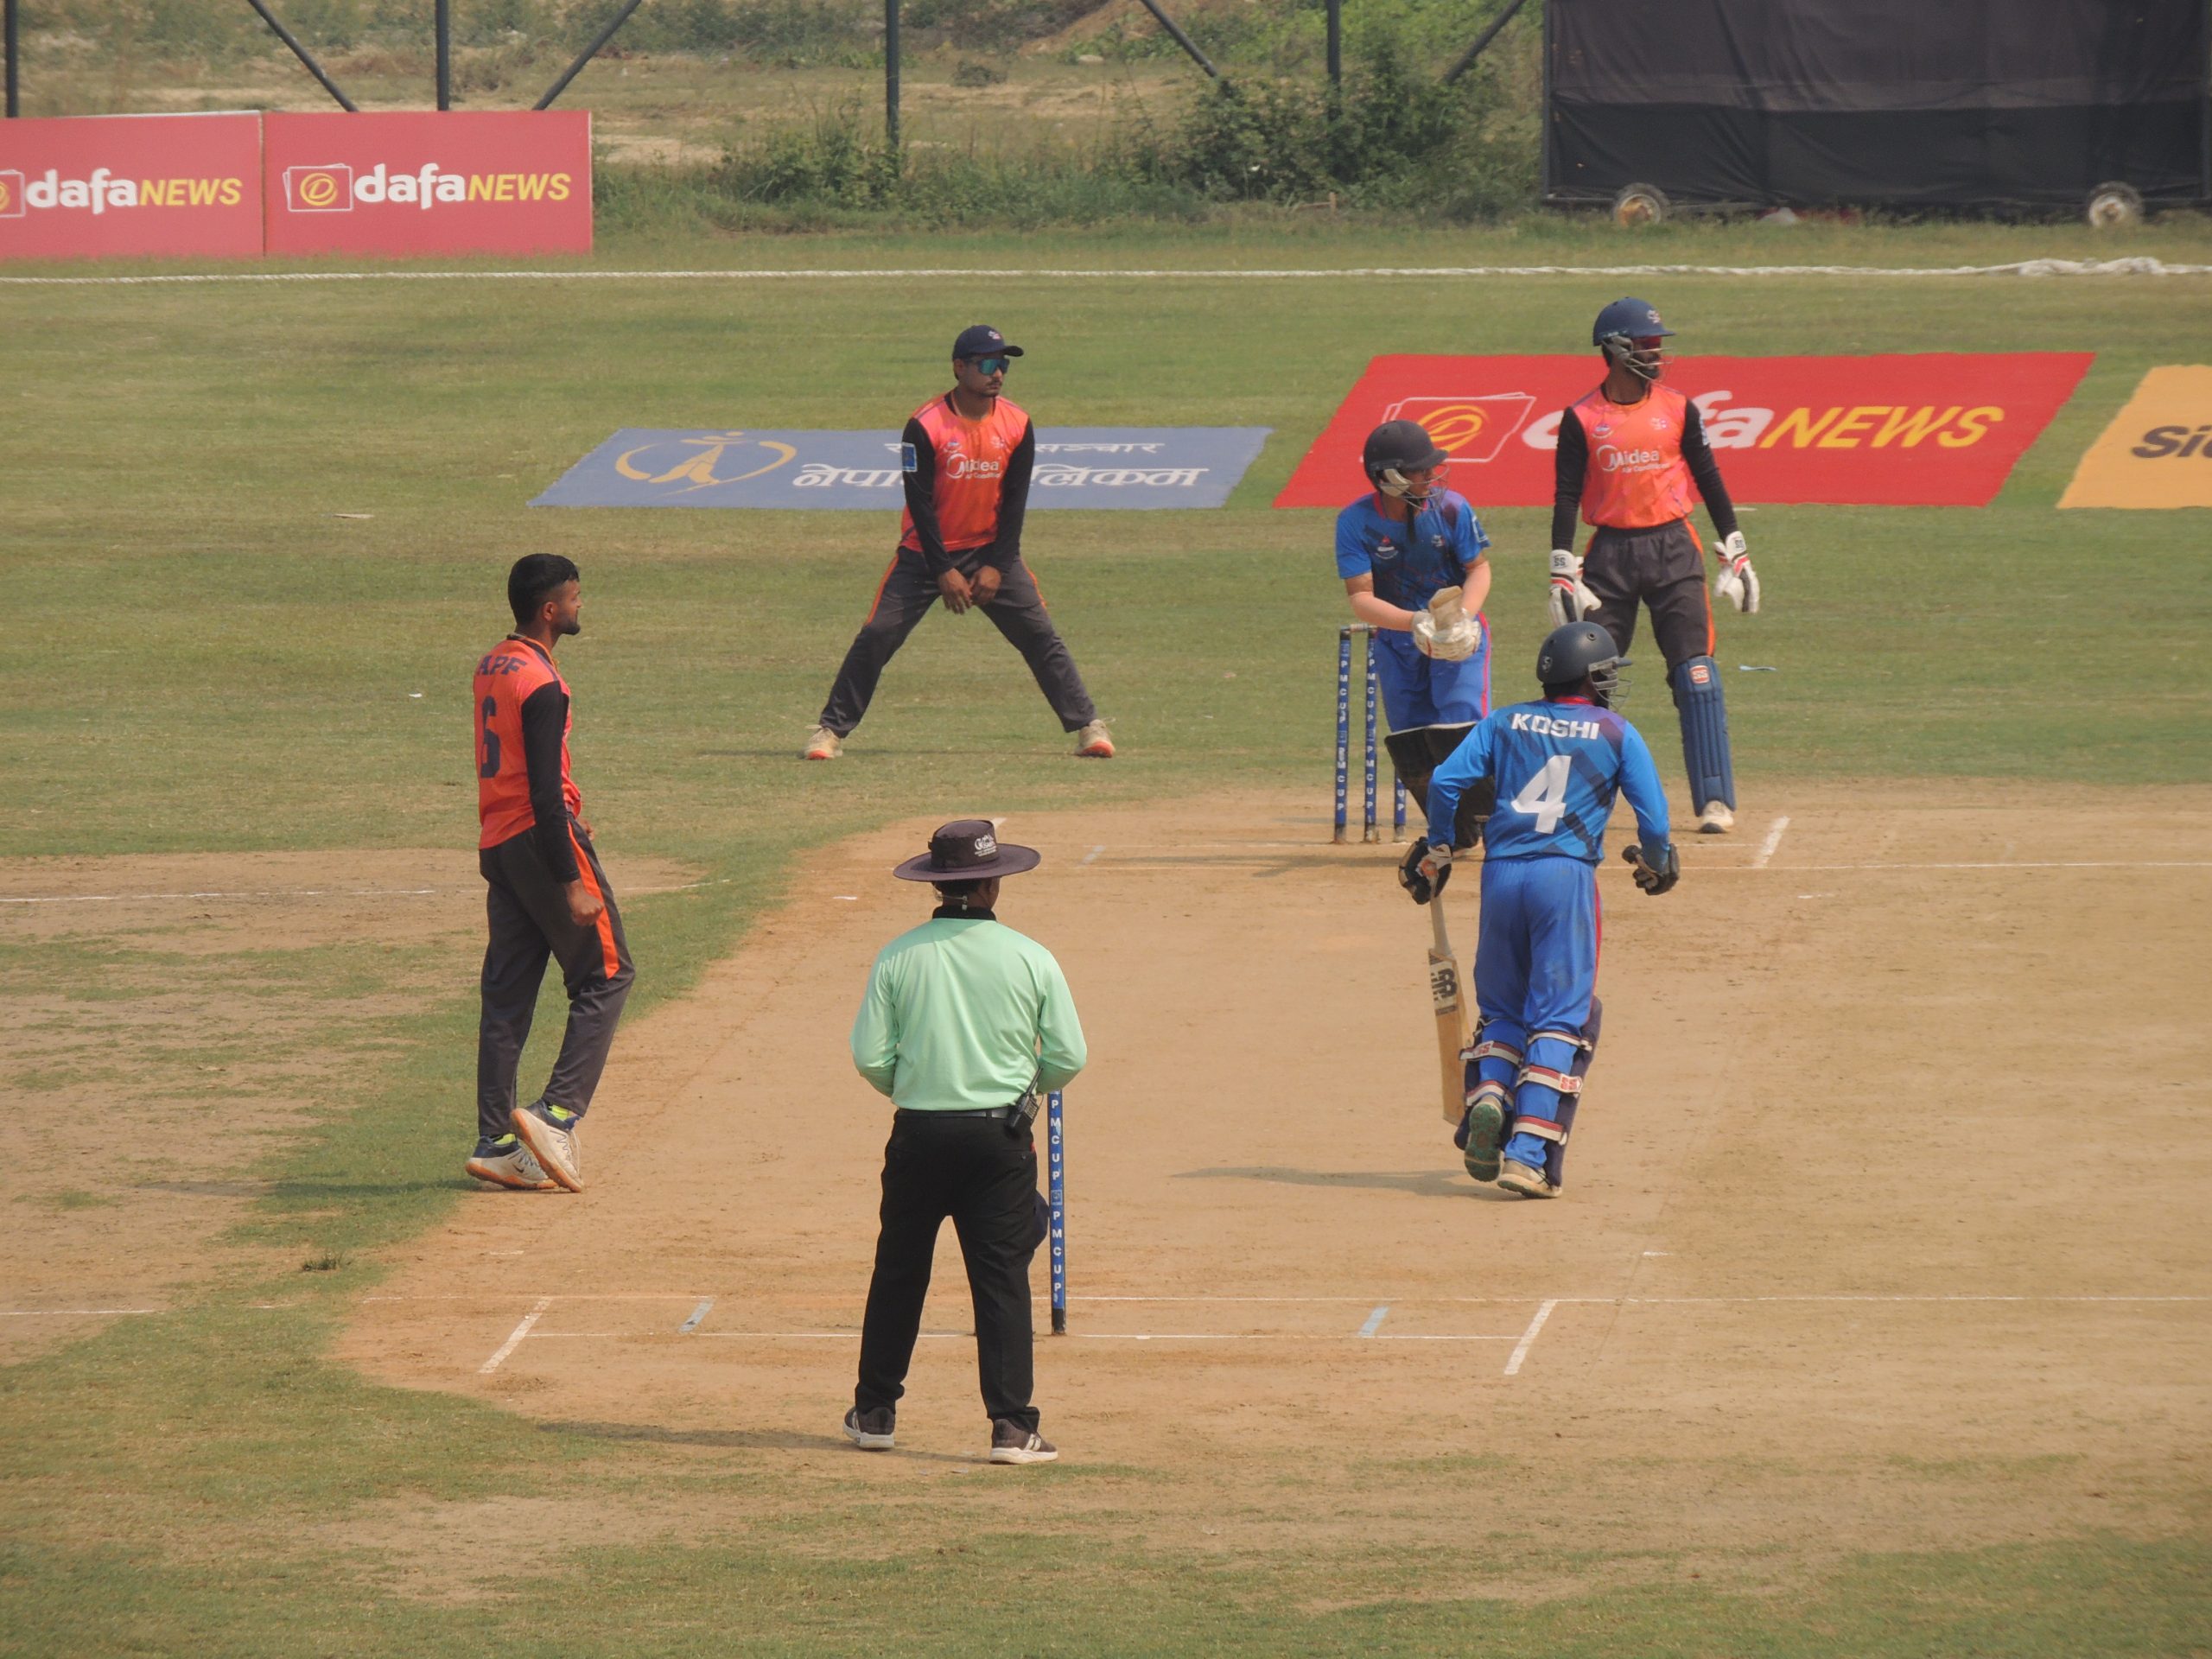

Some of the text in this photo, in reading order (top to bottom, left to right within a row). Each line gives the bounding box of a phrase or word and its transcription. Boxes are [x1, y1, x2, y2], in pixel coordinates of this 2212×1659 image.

[26, 168, 243, 215] dafaNEWS
[353, 162, 571, 210] dafaNEWS
[792, 463, 905, 486] नेपा
[1597, 445, 1659, 472] Midea
[476, 655, 526, 677] APF
[480, 695, 500, 779] 6
[1511, 713, 1600, 741] KOSHI
[1510, 754, 1573, 835] 4
